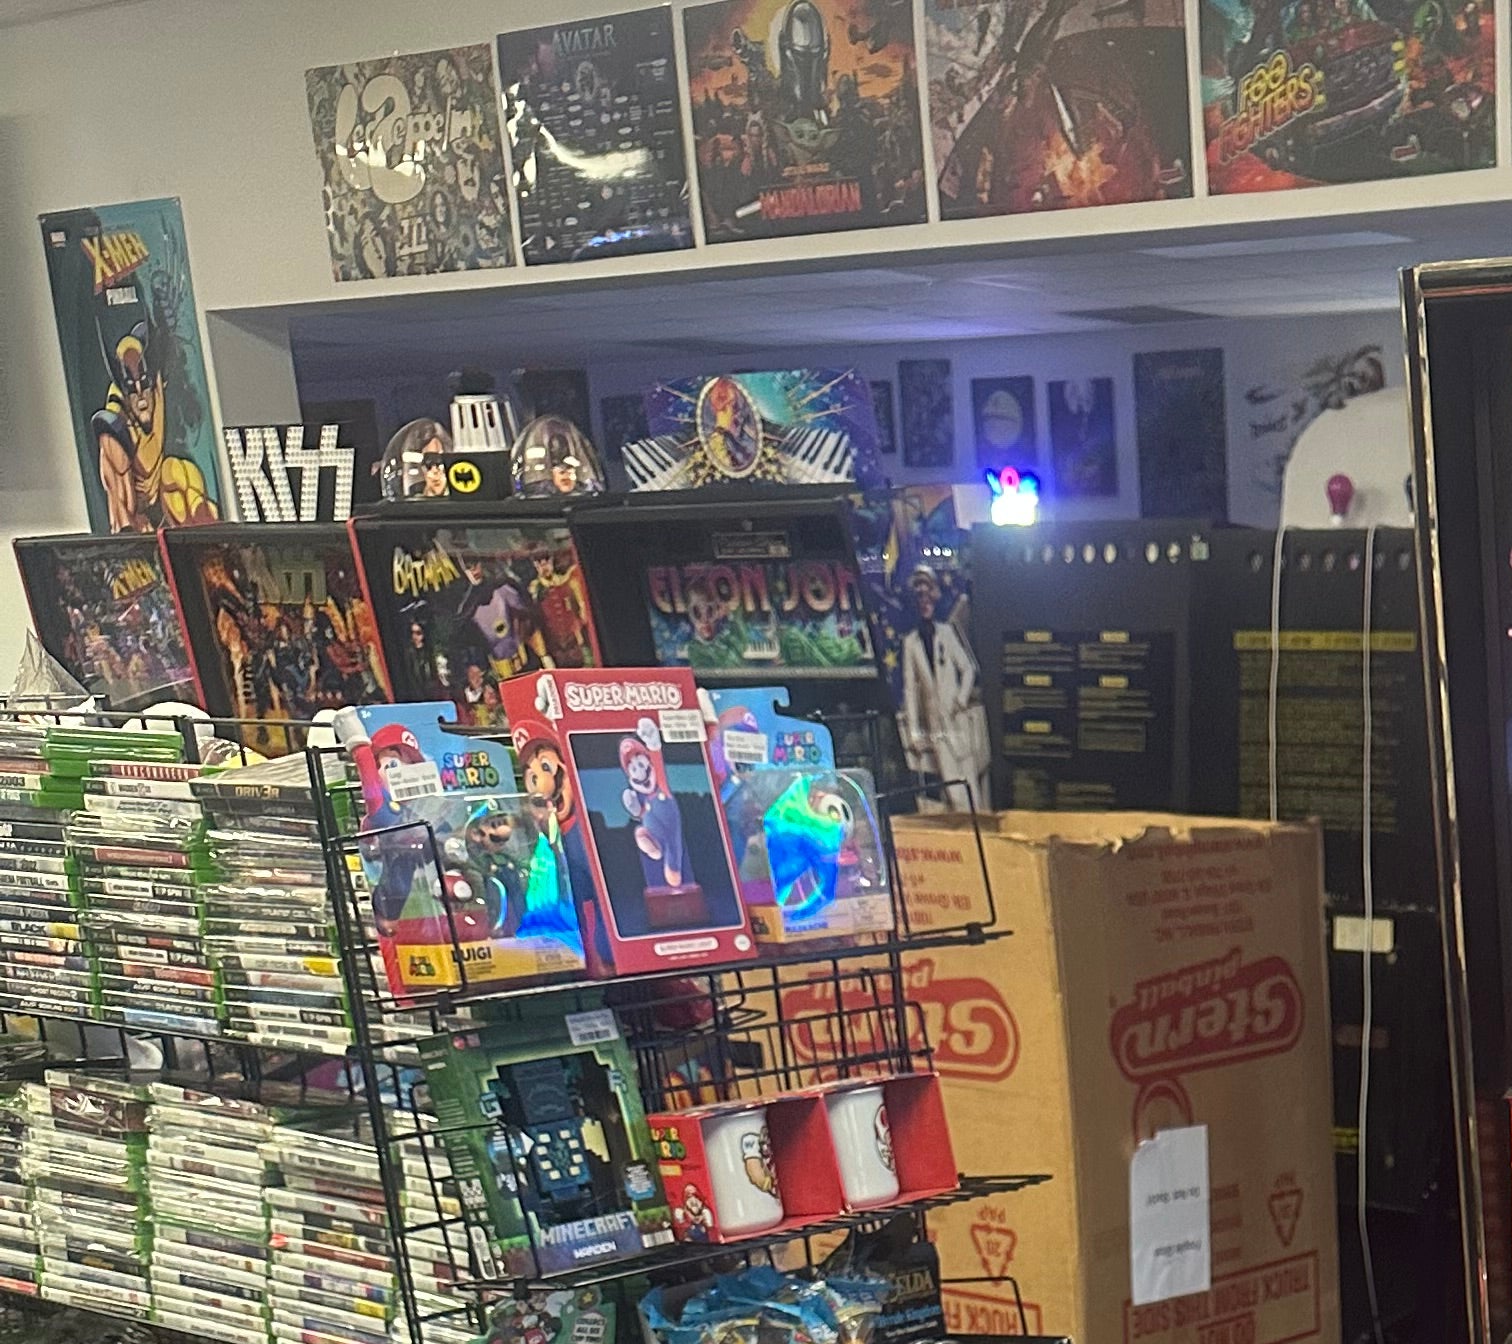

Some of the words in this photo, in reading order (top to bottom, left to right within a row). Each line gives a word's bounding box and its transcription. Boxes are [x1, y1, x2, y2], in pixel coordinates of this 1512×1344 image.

[552, 24, 616, 50] AVATAR
[1242, 52, 1291, 108] FOO
[1218, 66, 1322, 166] FIGHTERS
[80, 231, 151, 291] X-MEN
[222, 424, 355, 523] KISS
[393, 548, 461, 598] BATMAN
[566, 684, 628, 710] SUPER
[625, 685, 682, 708] MARIO
[441, 766, 500, 789] MARIO
[443, 750, 490, 769] SUPER
[11, 920, 46, 936] BLACK
[451, 945, 493, 963] LUIGI
[1134, 947, 1243, 1004] pinball
[1133, 978, 1287, 1064] Stern
[540, 1212, 638, 1248] MINECRAFT
[1215, 1279, 1258, 1317] FROM
[1263, 1263, 1310, 1303] TRUCK
[1132, 1303, 1170, 1339] SIDE
[1175, 1292, 1210, 1328] THIS
